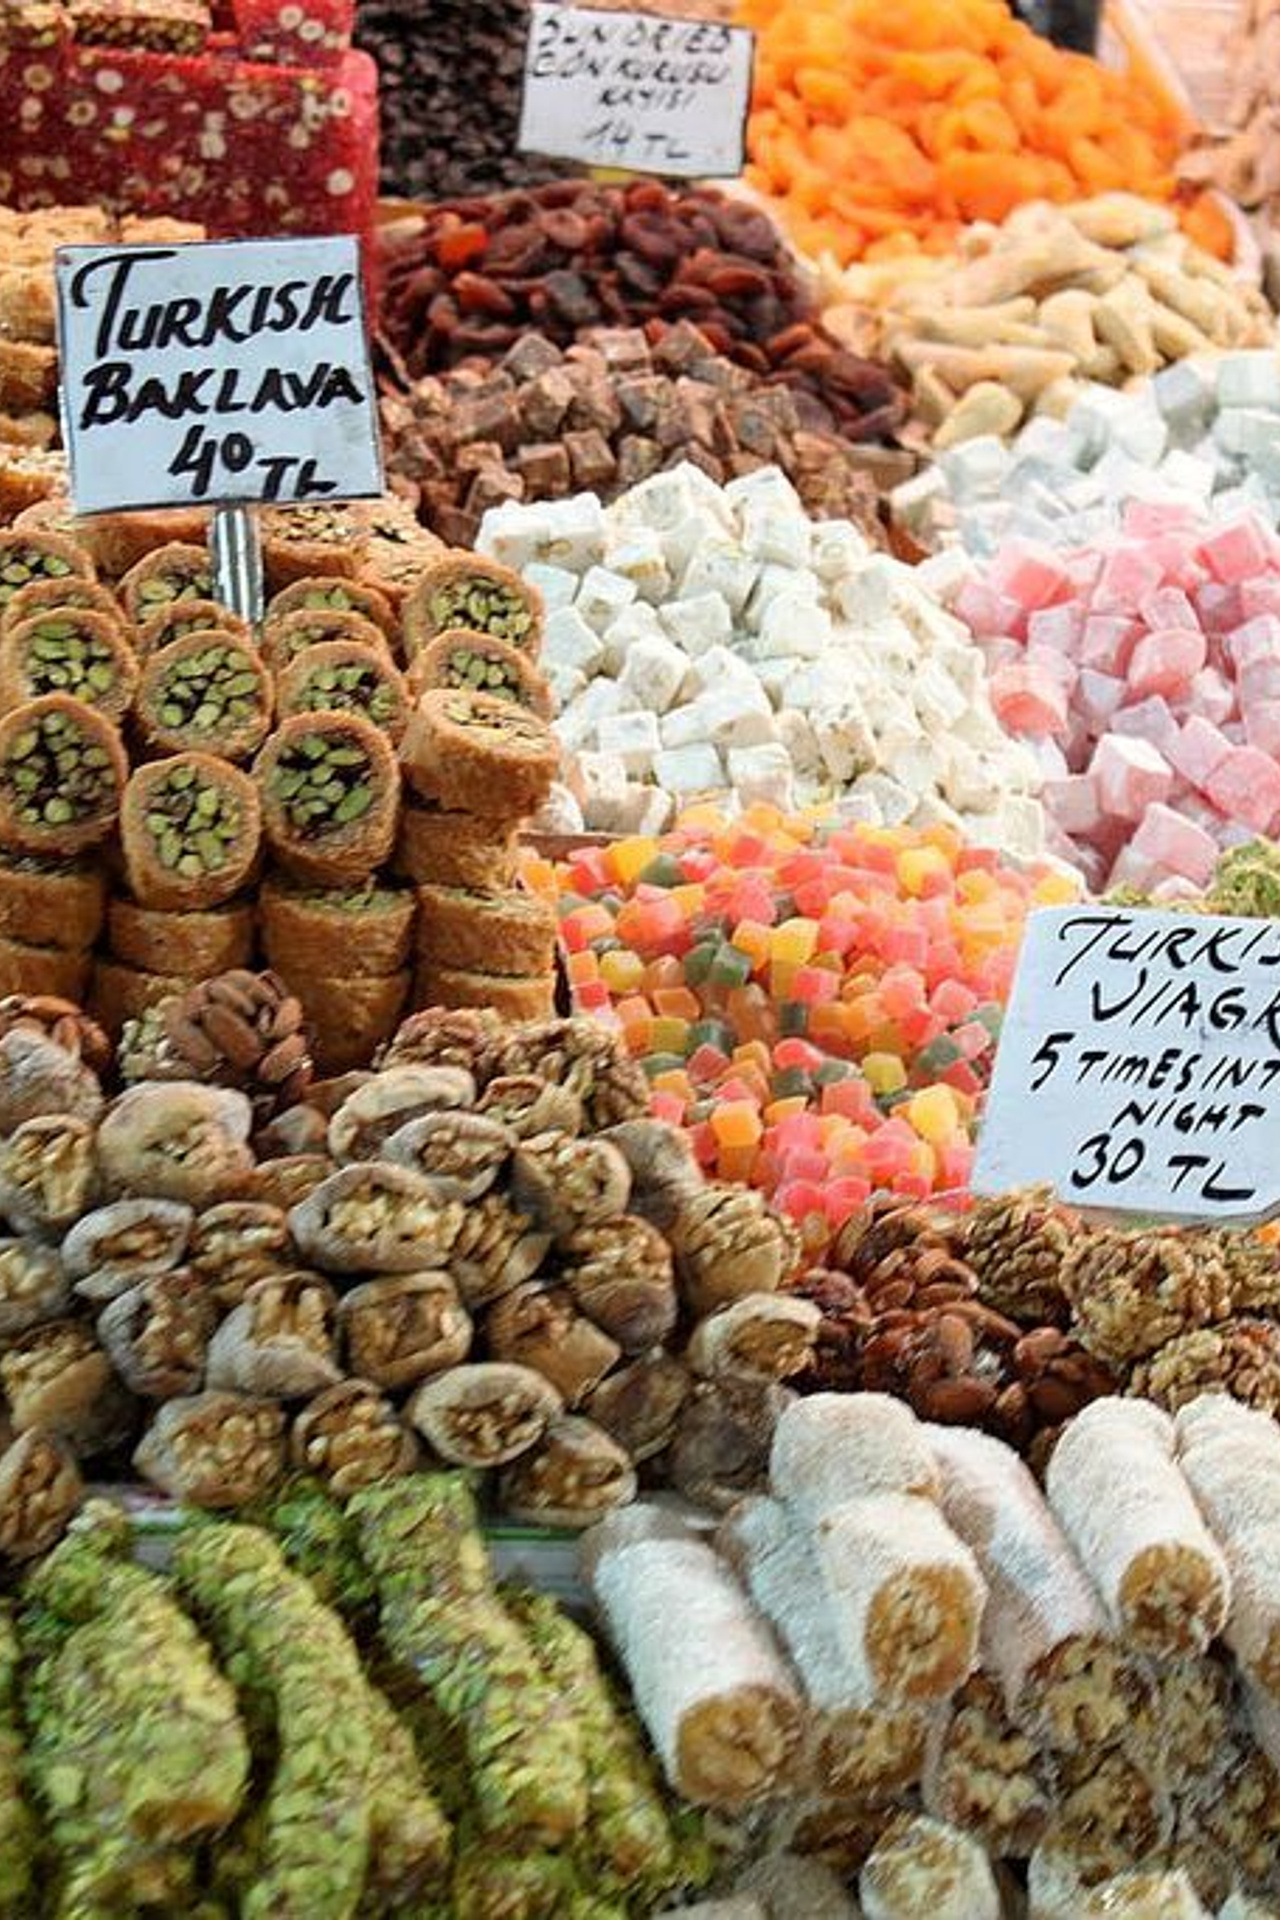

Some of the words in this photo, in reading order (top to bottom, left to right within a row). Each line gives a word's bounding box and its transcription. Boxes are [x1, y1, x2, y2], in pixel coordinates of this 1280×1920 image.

[645, 133, 690, 159] TL
[71, 250, 354, 359] TURKISH
[80, 362, 366, 430] BAKLAVA
[168, 424, 253, 496] 40
[257, 457, 338, 499] TL
[1031, 1032, 1076, 1092] 5
[1110, 1099, 1266, 1133] NIGHT
[1070, 1132, 1146, 1190] 30
[1167, 1154, 1256, 1200] TL
